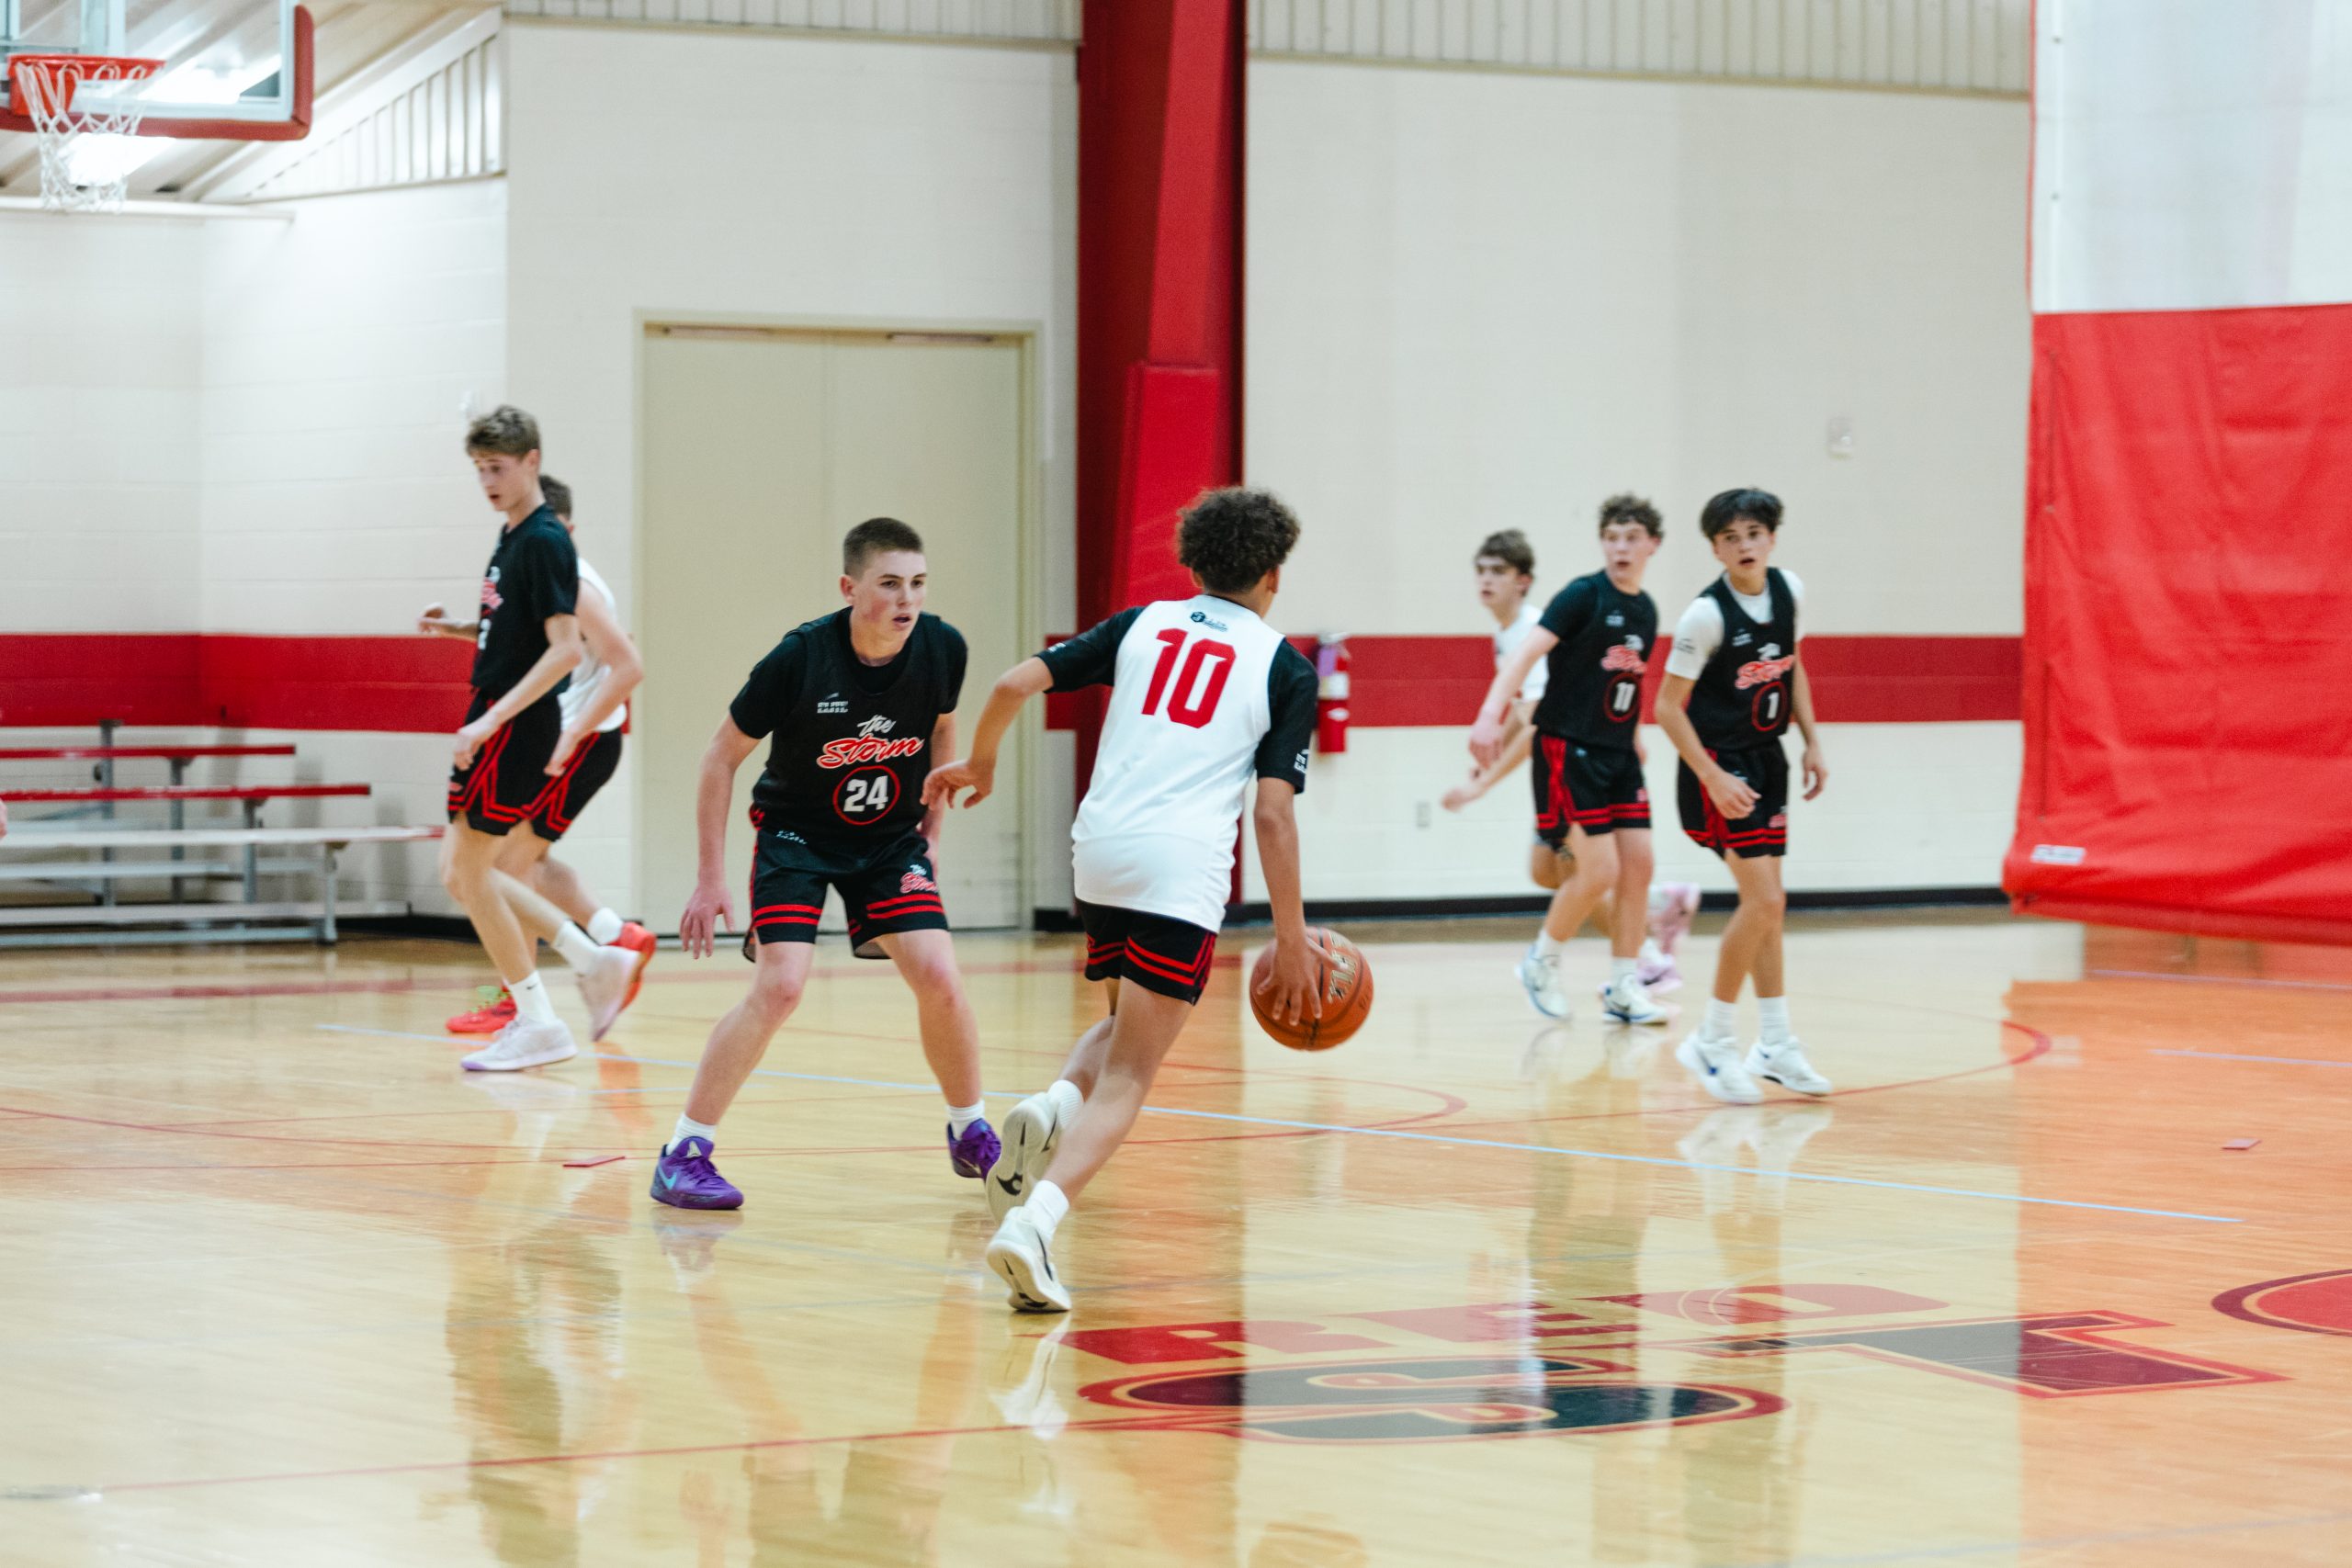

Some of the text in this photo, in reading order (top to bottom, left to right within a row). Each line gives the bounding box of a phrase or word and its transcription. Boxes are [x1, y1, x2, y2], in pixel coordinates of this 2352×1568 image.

[1141, 627, 1237, 728] 10
[1612, 682, 1636, 713] 11
[1767, 692, 1780, 719] 1
[816, 733, 925, 769] Storm
[843, 776, 888, 812] 24
